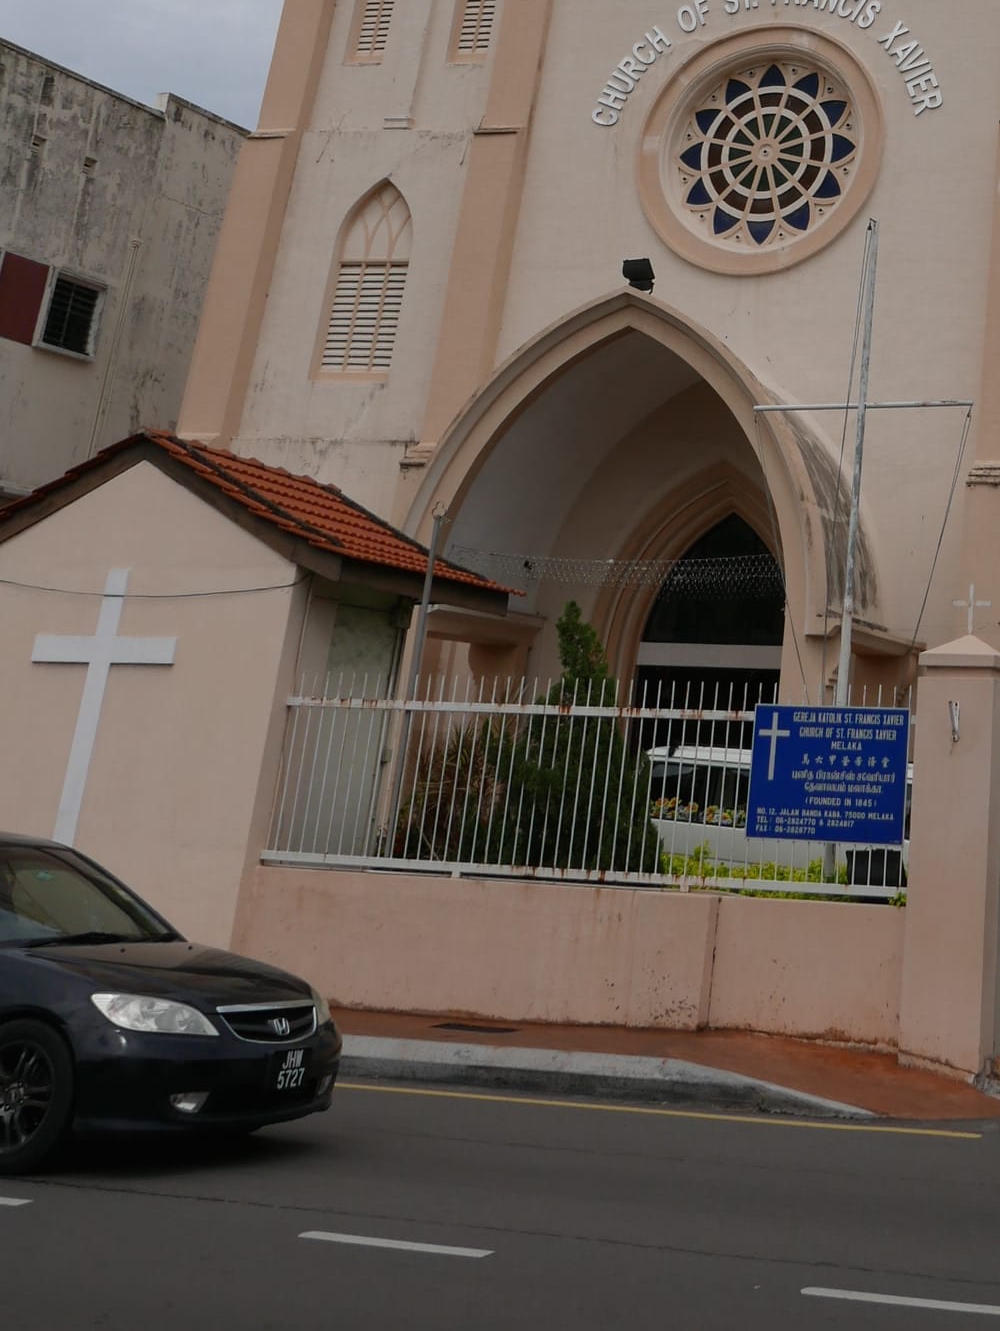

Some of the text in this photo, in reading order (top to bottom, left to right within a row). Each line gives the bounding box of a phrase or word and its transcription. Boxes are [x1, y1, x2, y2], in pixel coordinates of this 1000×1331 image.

[591, 25, 672, 127] CHURCH
[878, 20, 943, 117] XAVIER
[793, 712, 904, 726] GEREJA KATOLIK ST. FRANCIS XAVIER
[799, 727, 896, 741] CHURCH OF ST. FRANCIS XAVIER
[831, 741, 862, 750] MELAKA
[802, 809, 821, 817] BANDA
[868, 813, 894, 821] MELAKA
[277, 1068, 305, 1089] 5727
